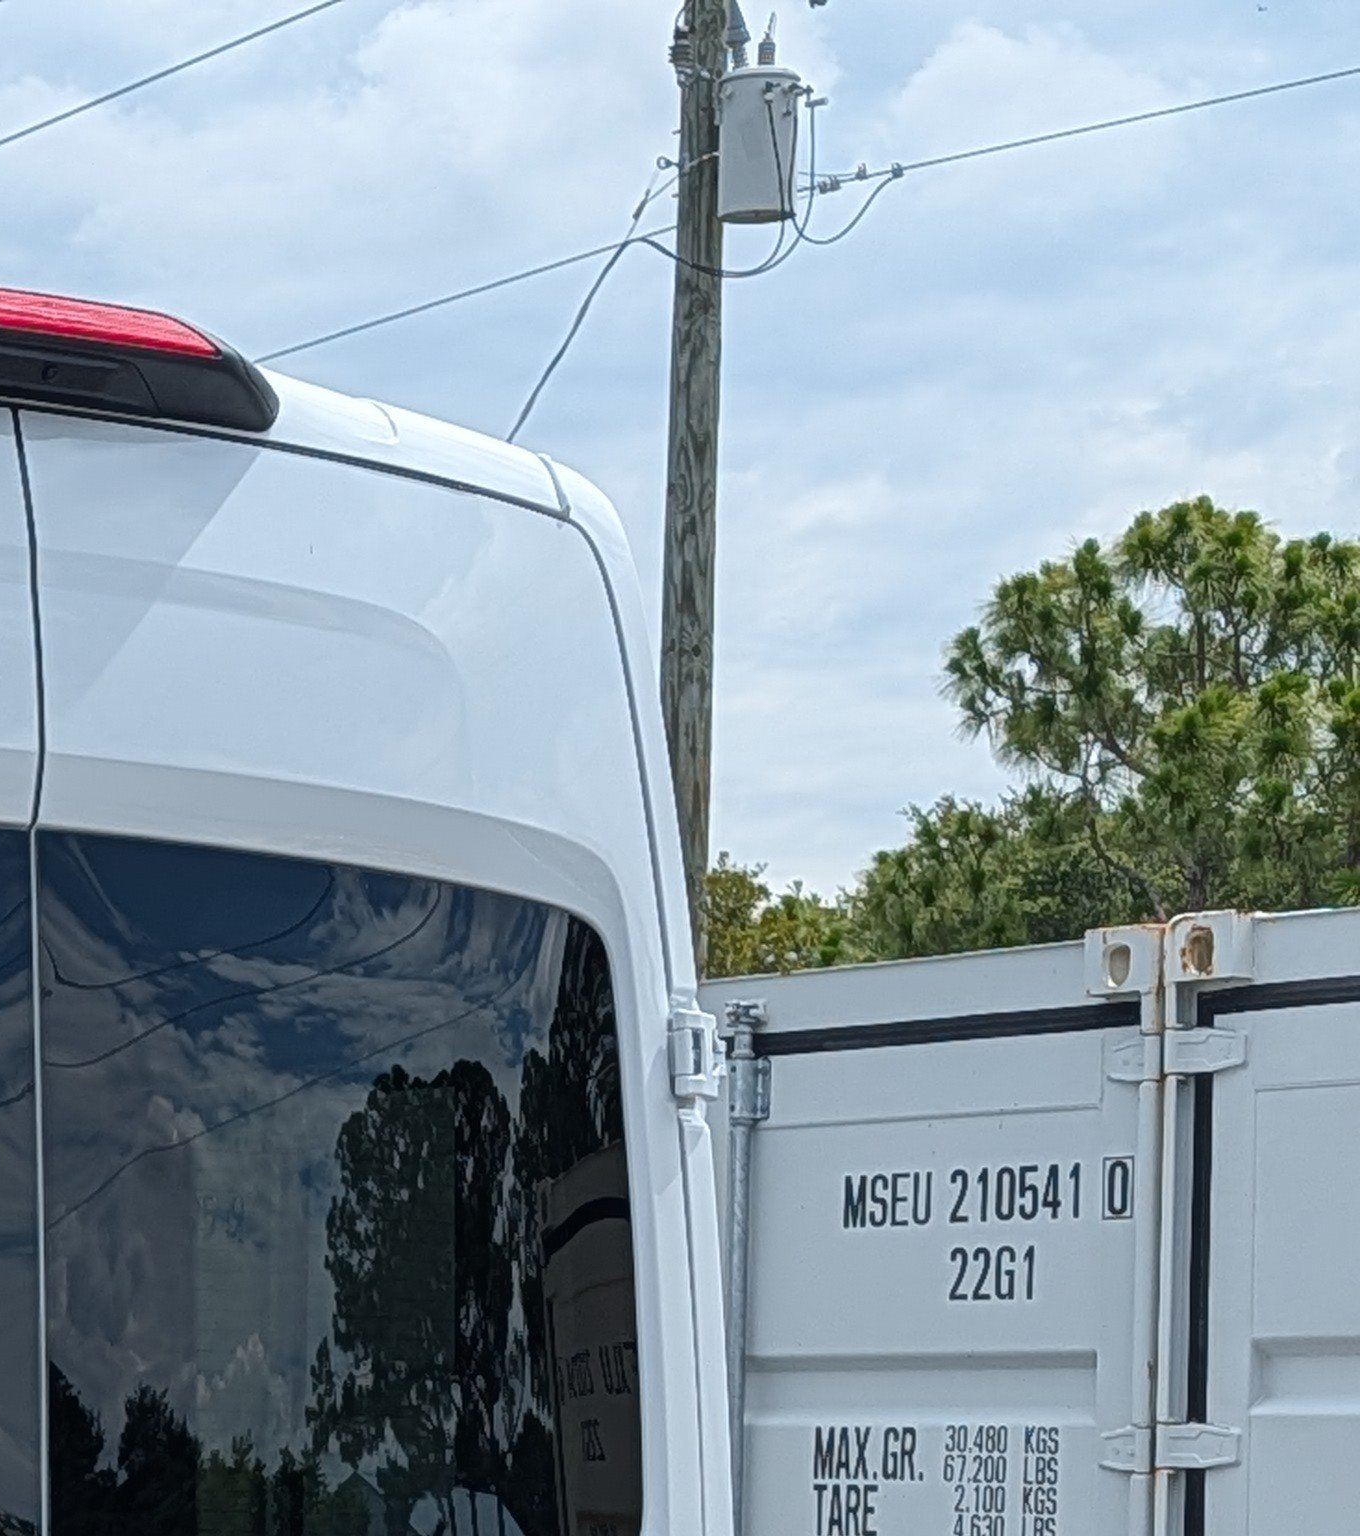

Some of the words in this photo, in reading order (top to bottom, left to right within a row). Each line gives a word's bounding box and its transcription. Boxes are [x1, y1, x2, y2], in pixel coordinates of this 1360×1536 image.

[843, 1171, 932, 1229] MSEU
[949, 1162, 1081, 1223] 210541
[1107, 1160, 1129, 1215] 0
[949, 1245, 1035, 1301] 22G1
[1024, 1426, 1059, 1455] KGS
[1023, 1456, 1058, 1485] LBS
[954, 1485, 1005, 1513] 2.100
[1022, 1486, 1057, 1515] KGS
